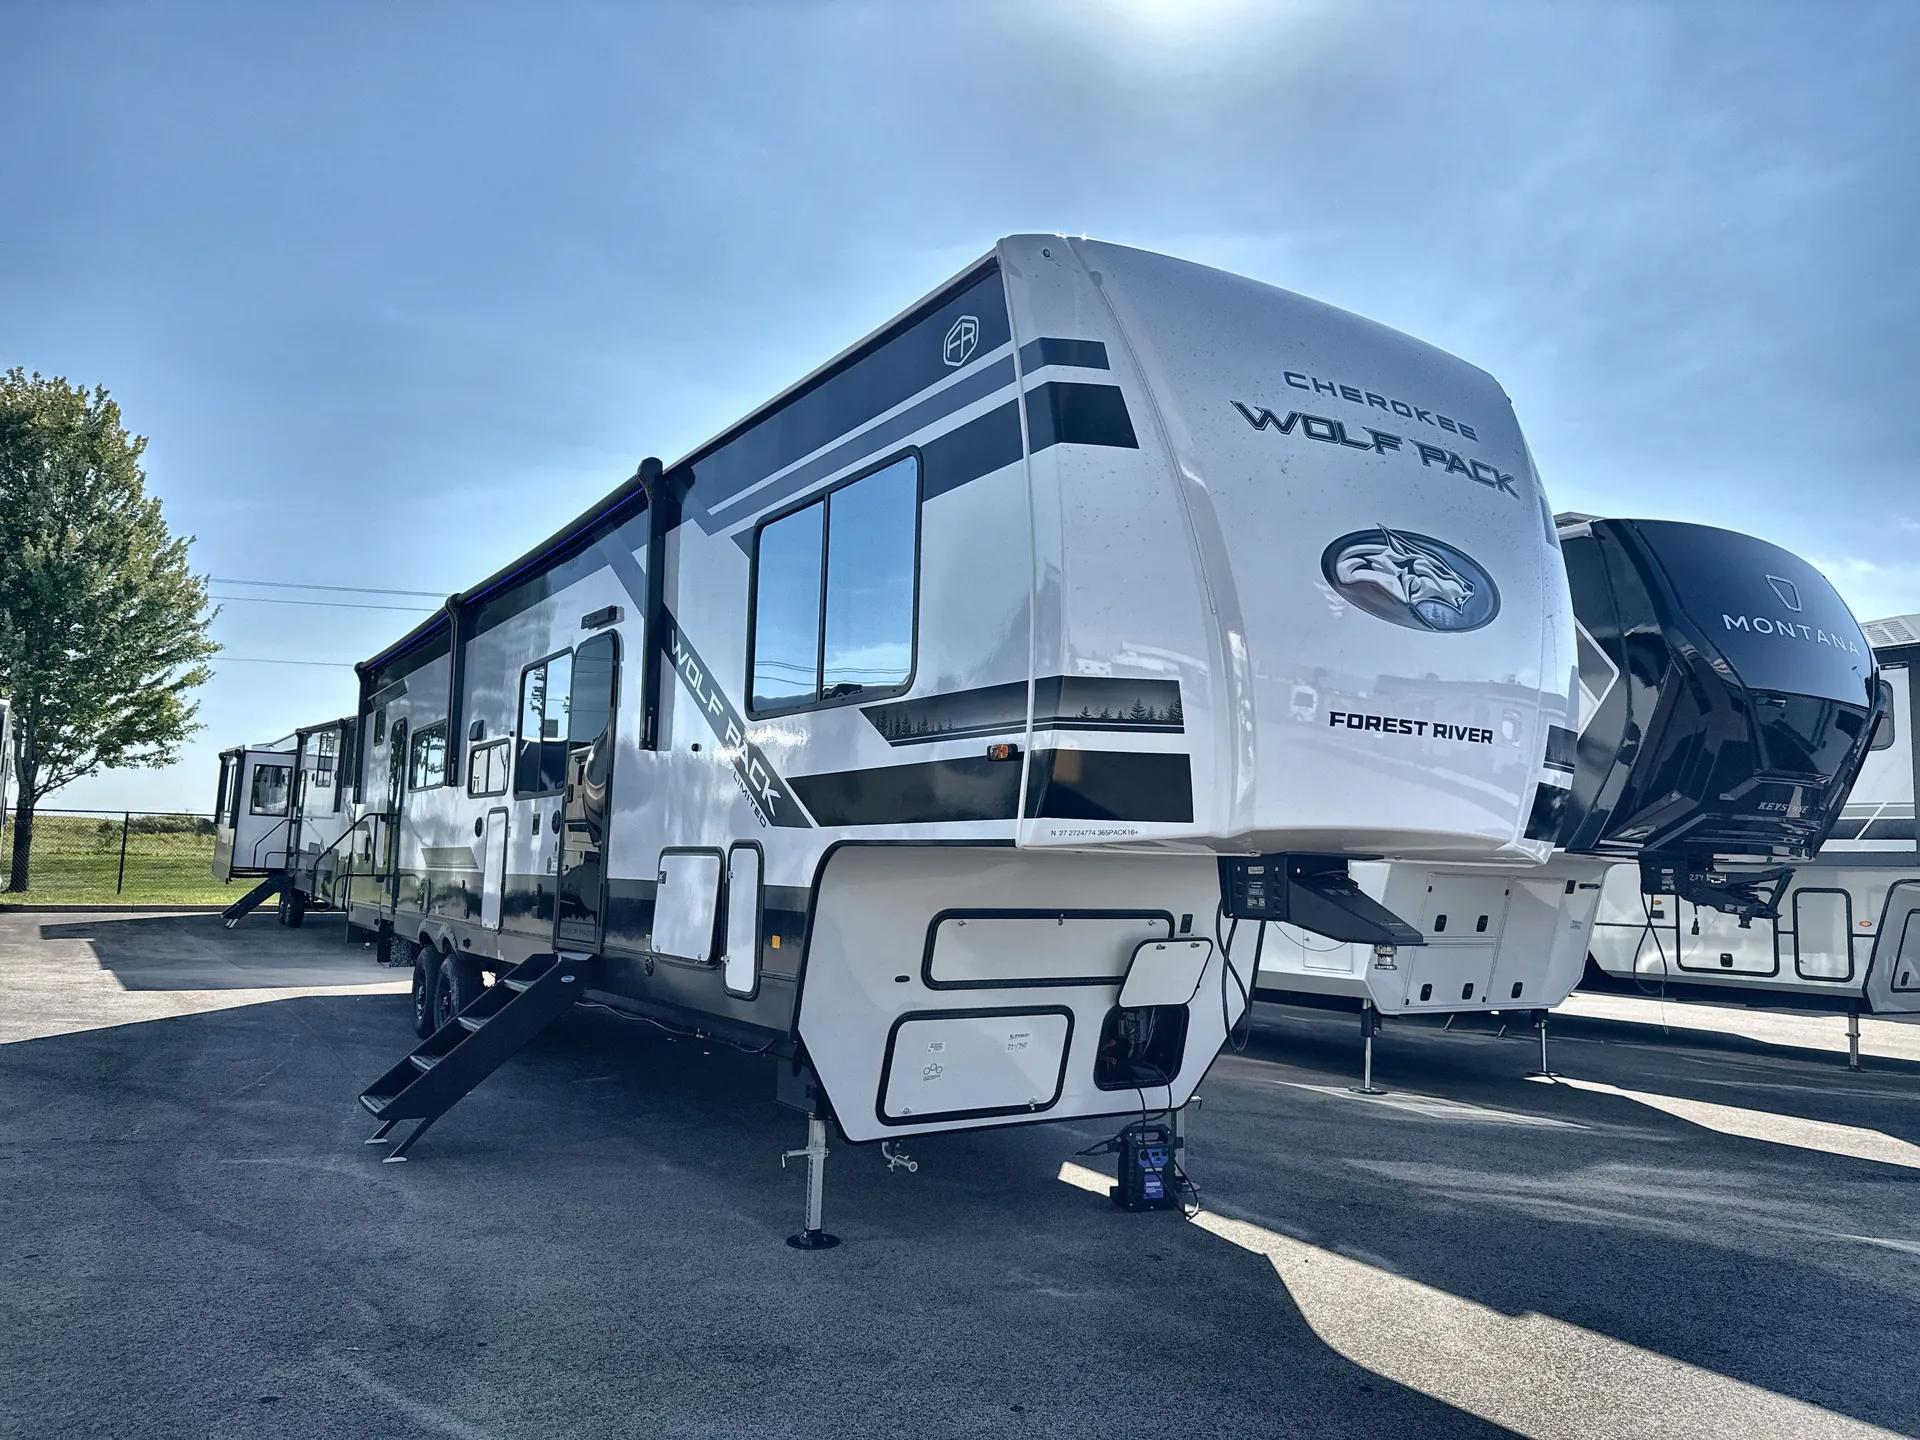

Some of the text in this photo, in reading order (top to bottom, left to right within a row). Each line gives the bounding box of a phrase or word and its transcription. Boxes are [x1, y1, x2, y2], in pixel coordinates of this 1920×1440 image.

[1283, 370, 1479, 442] CHEROKEE
[1230, 400, 1520, 500] WOLF PACK
[1722, 614, 1861, 657] MONTANA
[671, 629, 781, 818] WOLF PACK
[1329, 710, 1493, 744] FOREST RIVER
[732, 771, 768, 829] LIMITED
[1757, 801, 1810, 814] KEYSTONE
[1068, 829, 1096, 837] 2724774
